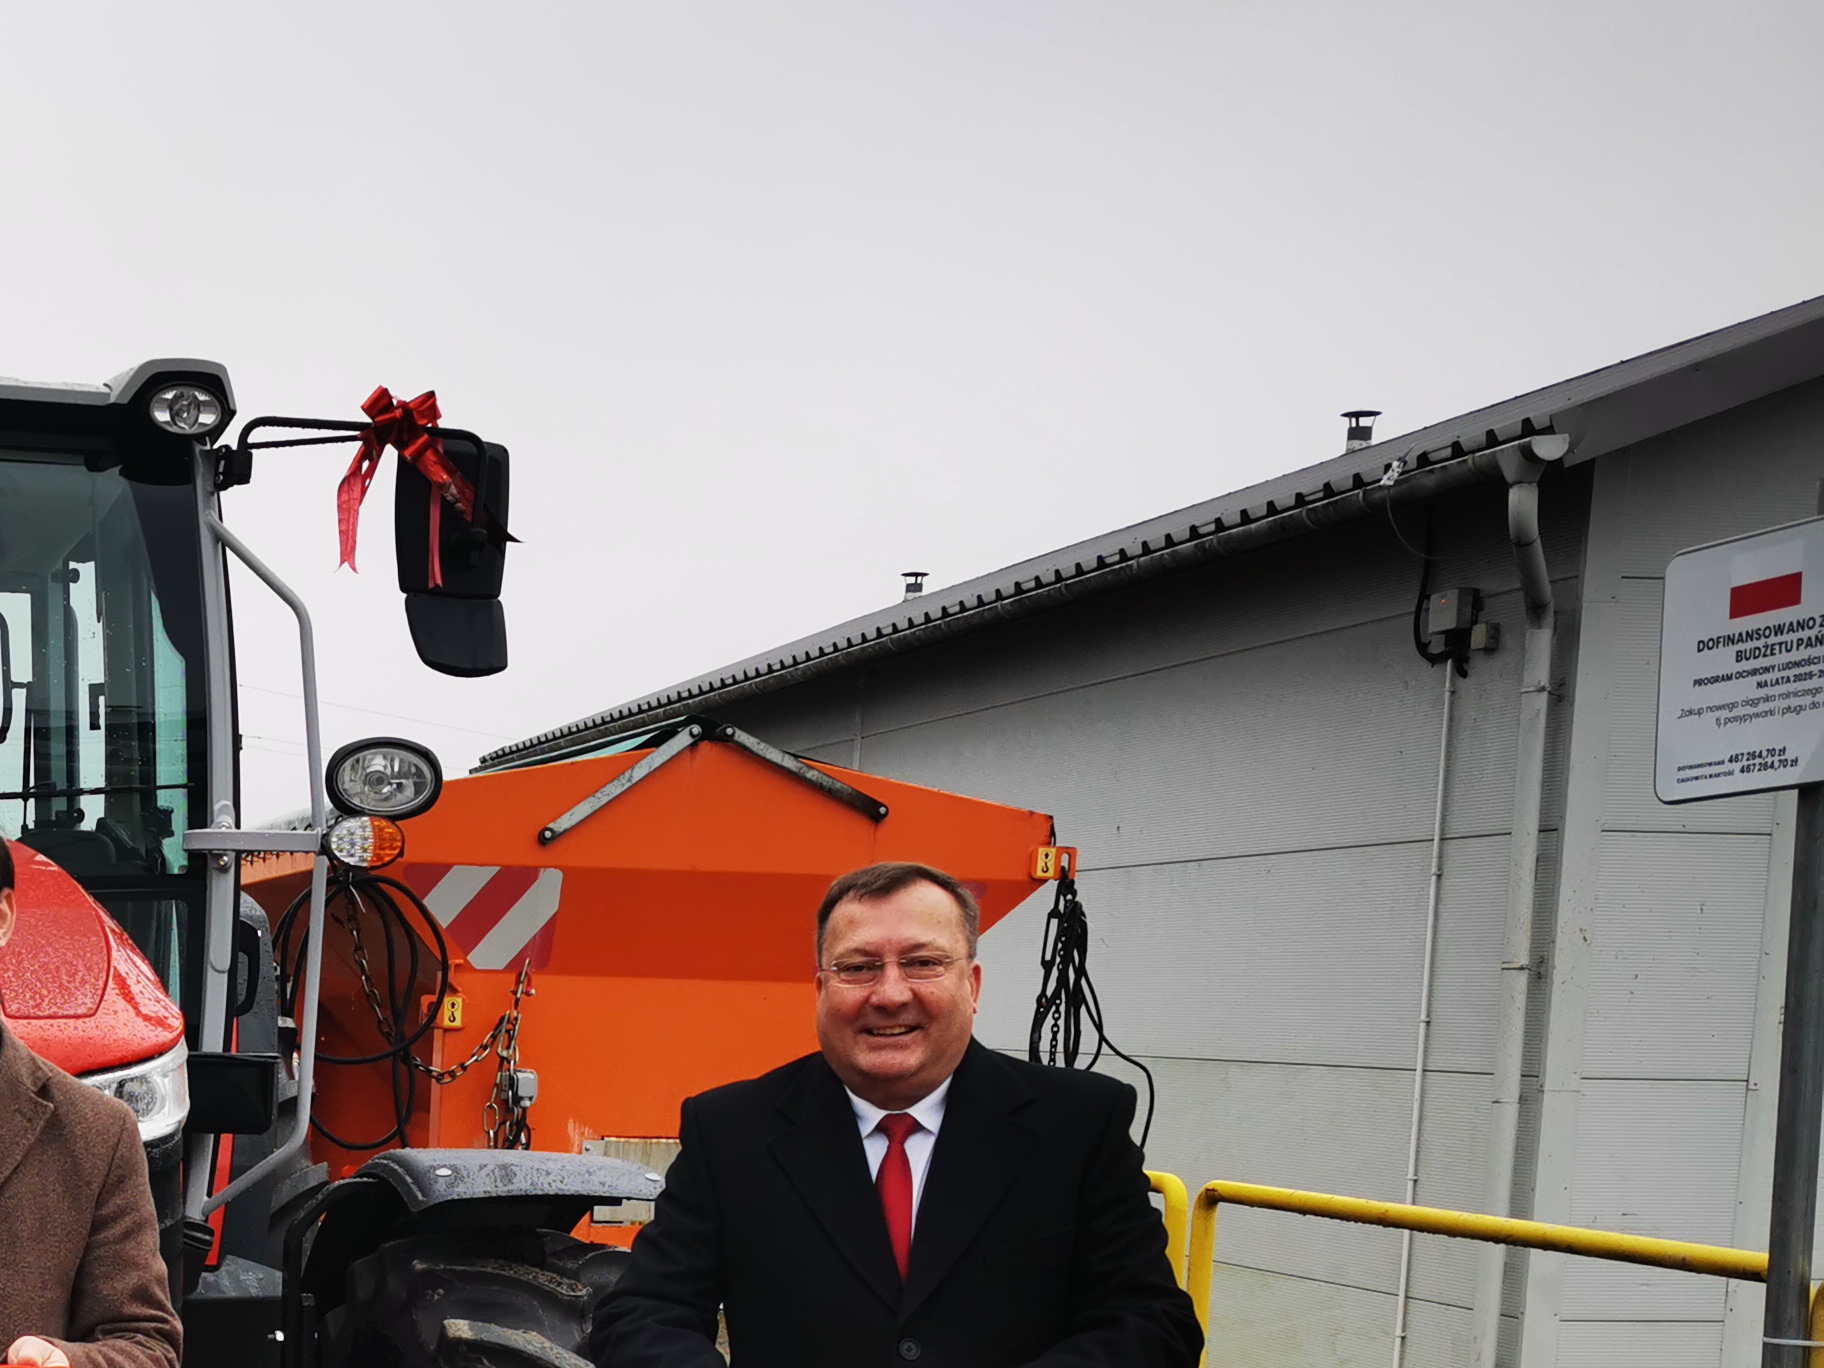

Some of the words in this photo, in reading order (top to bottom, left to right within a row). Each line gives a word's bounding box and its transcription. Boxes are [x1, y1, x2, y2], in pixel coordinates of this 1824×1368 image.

[1697, 616, 1816, 653] DOFINANSOWANO
[1735, 639, 1794, 663] BUDŻETU
[1693, 672, 1733, 688] PROGRAM
[1734, 664, 1776, 680] OCHRONY
[1777, 655, 1821, 672] LUDNOŚCI
[1756, 679, 1769, 690] NA
[1770, 675, 1791, 688] LATA
[1792, 669, 1824, 683] 2025-2
[1706, 700, 1739, 713] nowego
[1740, 694, 1776, 708] ciągnika
[1778, 685, 1823, 700] rolniczego
[1723, 707, 1776, 727] posypywarki
[1808, 700, 1821, 710] do
[1777, 745, 1786, 757] zł
[1789, 756, 1798, 767] zł
